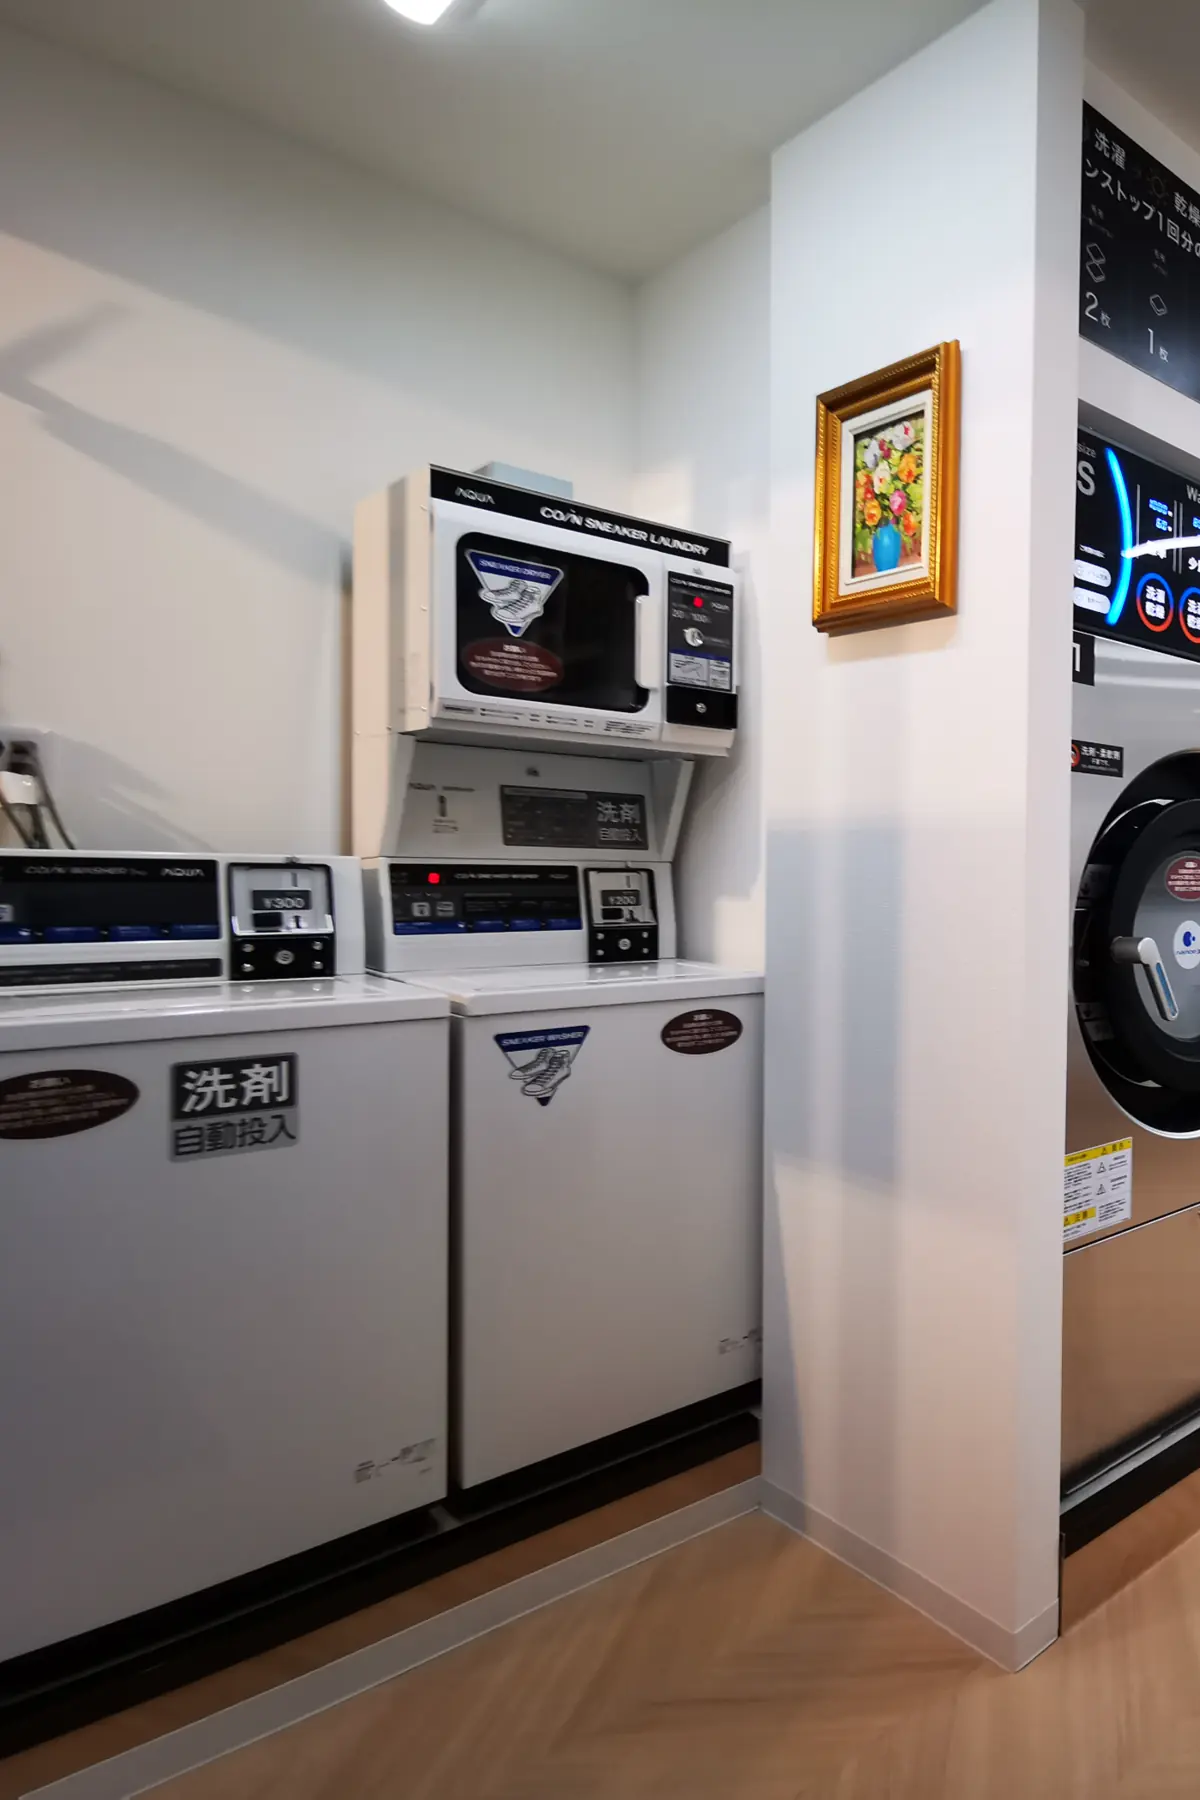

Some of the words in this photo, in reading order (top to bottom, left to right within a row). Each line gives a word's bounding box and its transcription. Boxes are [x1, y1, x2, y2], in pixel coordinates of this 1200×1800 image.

[1094, 128, 1126, 170] 洗濯
[455, 487, 496, 504] AQUA
[1077, 460, 1095, 497] S
[540, 506, 583, 527] COIN
[585, 516, 648, 542] SNEAKER
[650, 533, 711, 557] LAUNDRY
[181, 1061, 290, 1113] 洗剤
[174, 1114, 296, 1156] 自動投入
